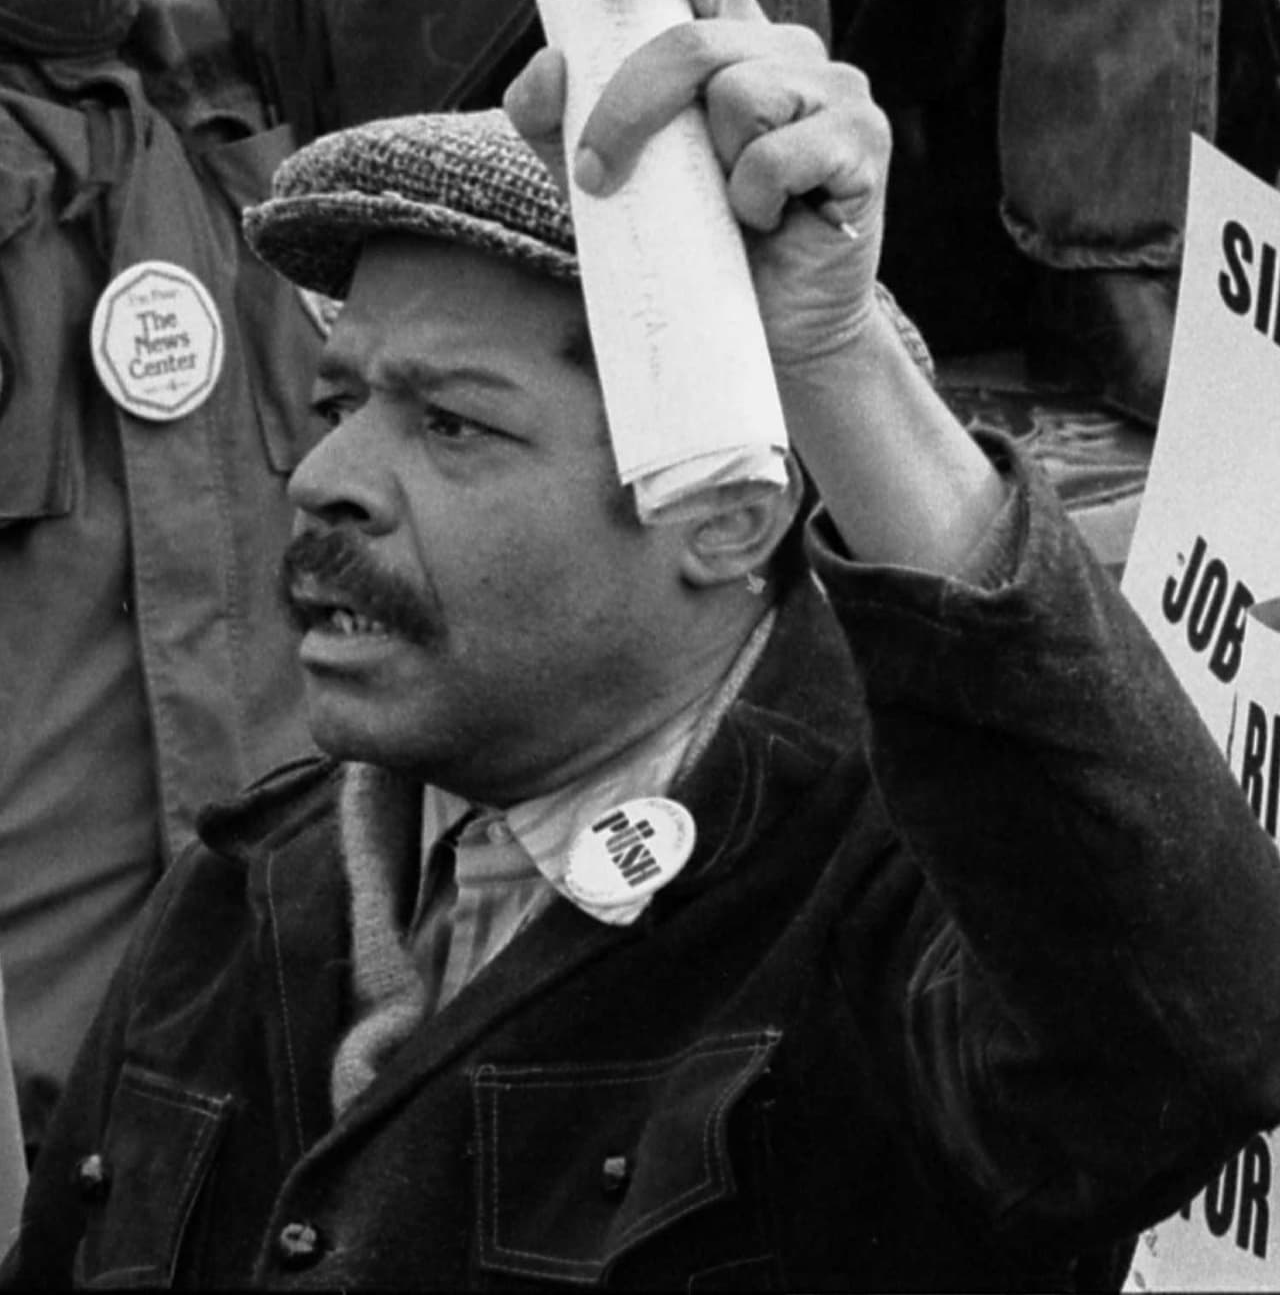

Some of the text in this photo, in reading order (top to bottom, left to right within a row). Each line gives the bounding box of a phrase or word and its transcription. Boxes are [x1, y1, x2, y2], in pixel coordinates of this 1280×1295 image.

[134, 332, 190, 357] News
[135, 310, 177, 340] The
[129, 353, 196, 380] Center
[1163, 535, 1254, 683] JOB
[592, 810, 662, 887] PUSH
[1180, 1134, 1271, 1260] OR
